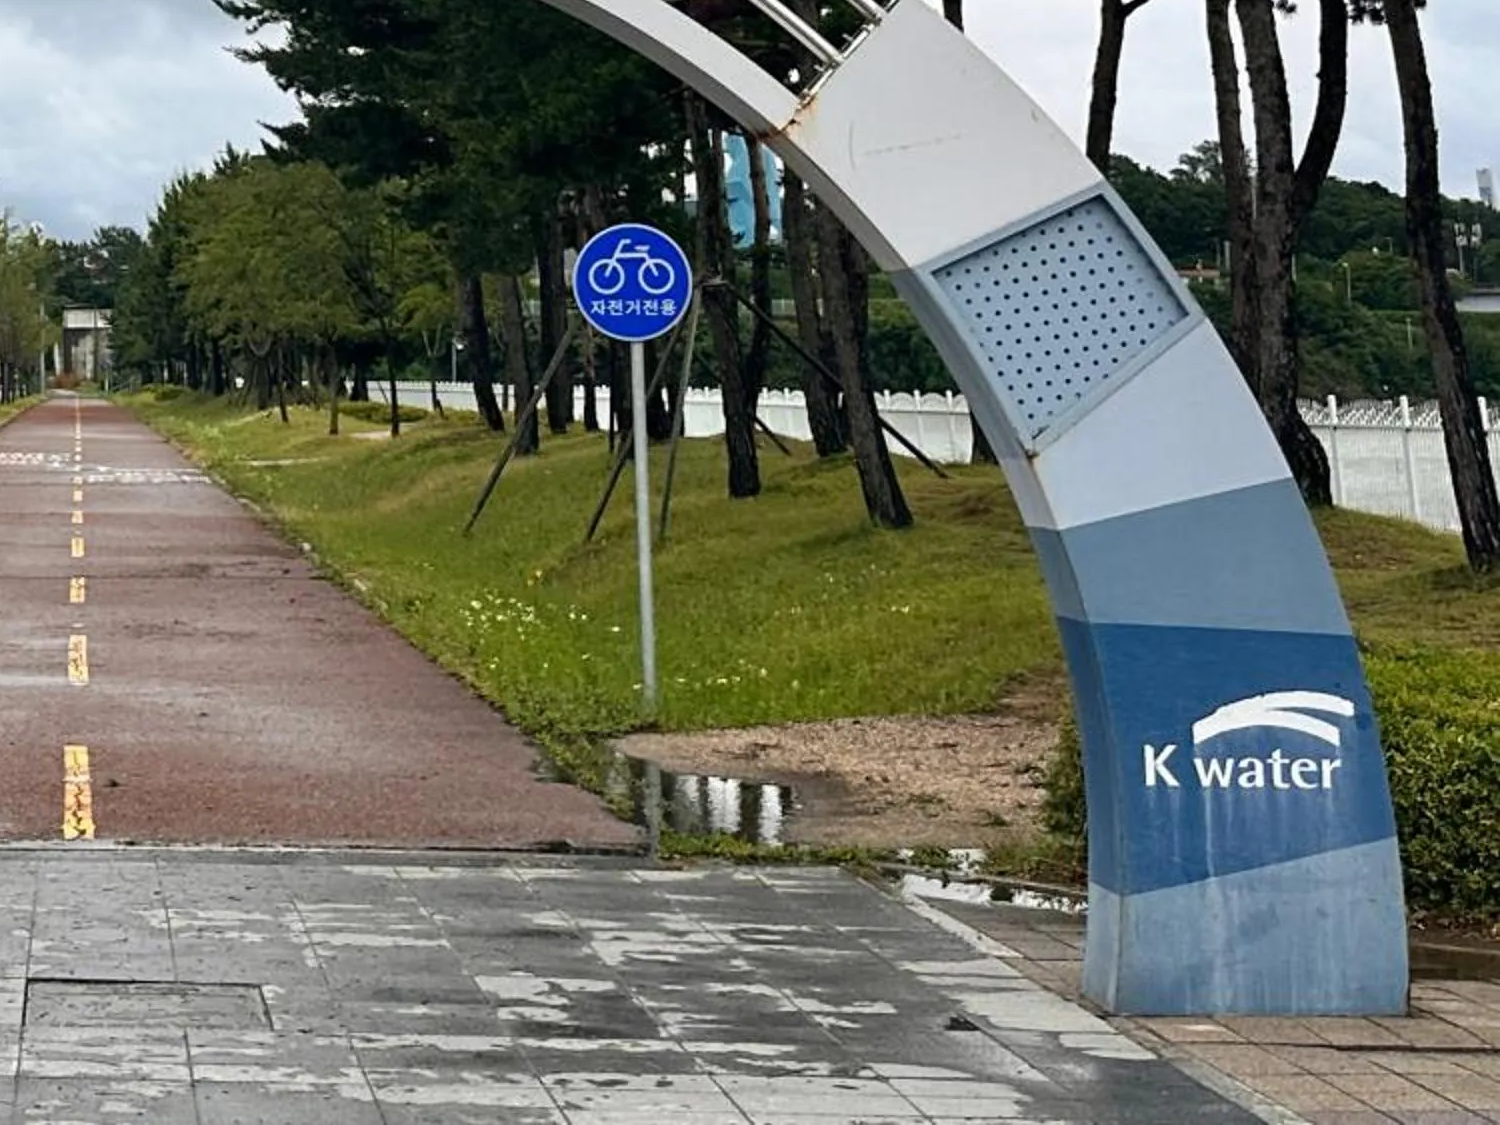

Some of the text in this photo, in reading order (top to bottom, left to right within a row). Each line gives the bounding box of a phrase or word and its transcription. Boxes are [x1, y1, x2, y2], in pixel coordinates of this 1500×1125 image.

[590, 298, 677, 316] 자전거전용
[1143, 743, 1342, 789] K water
